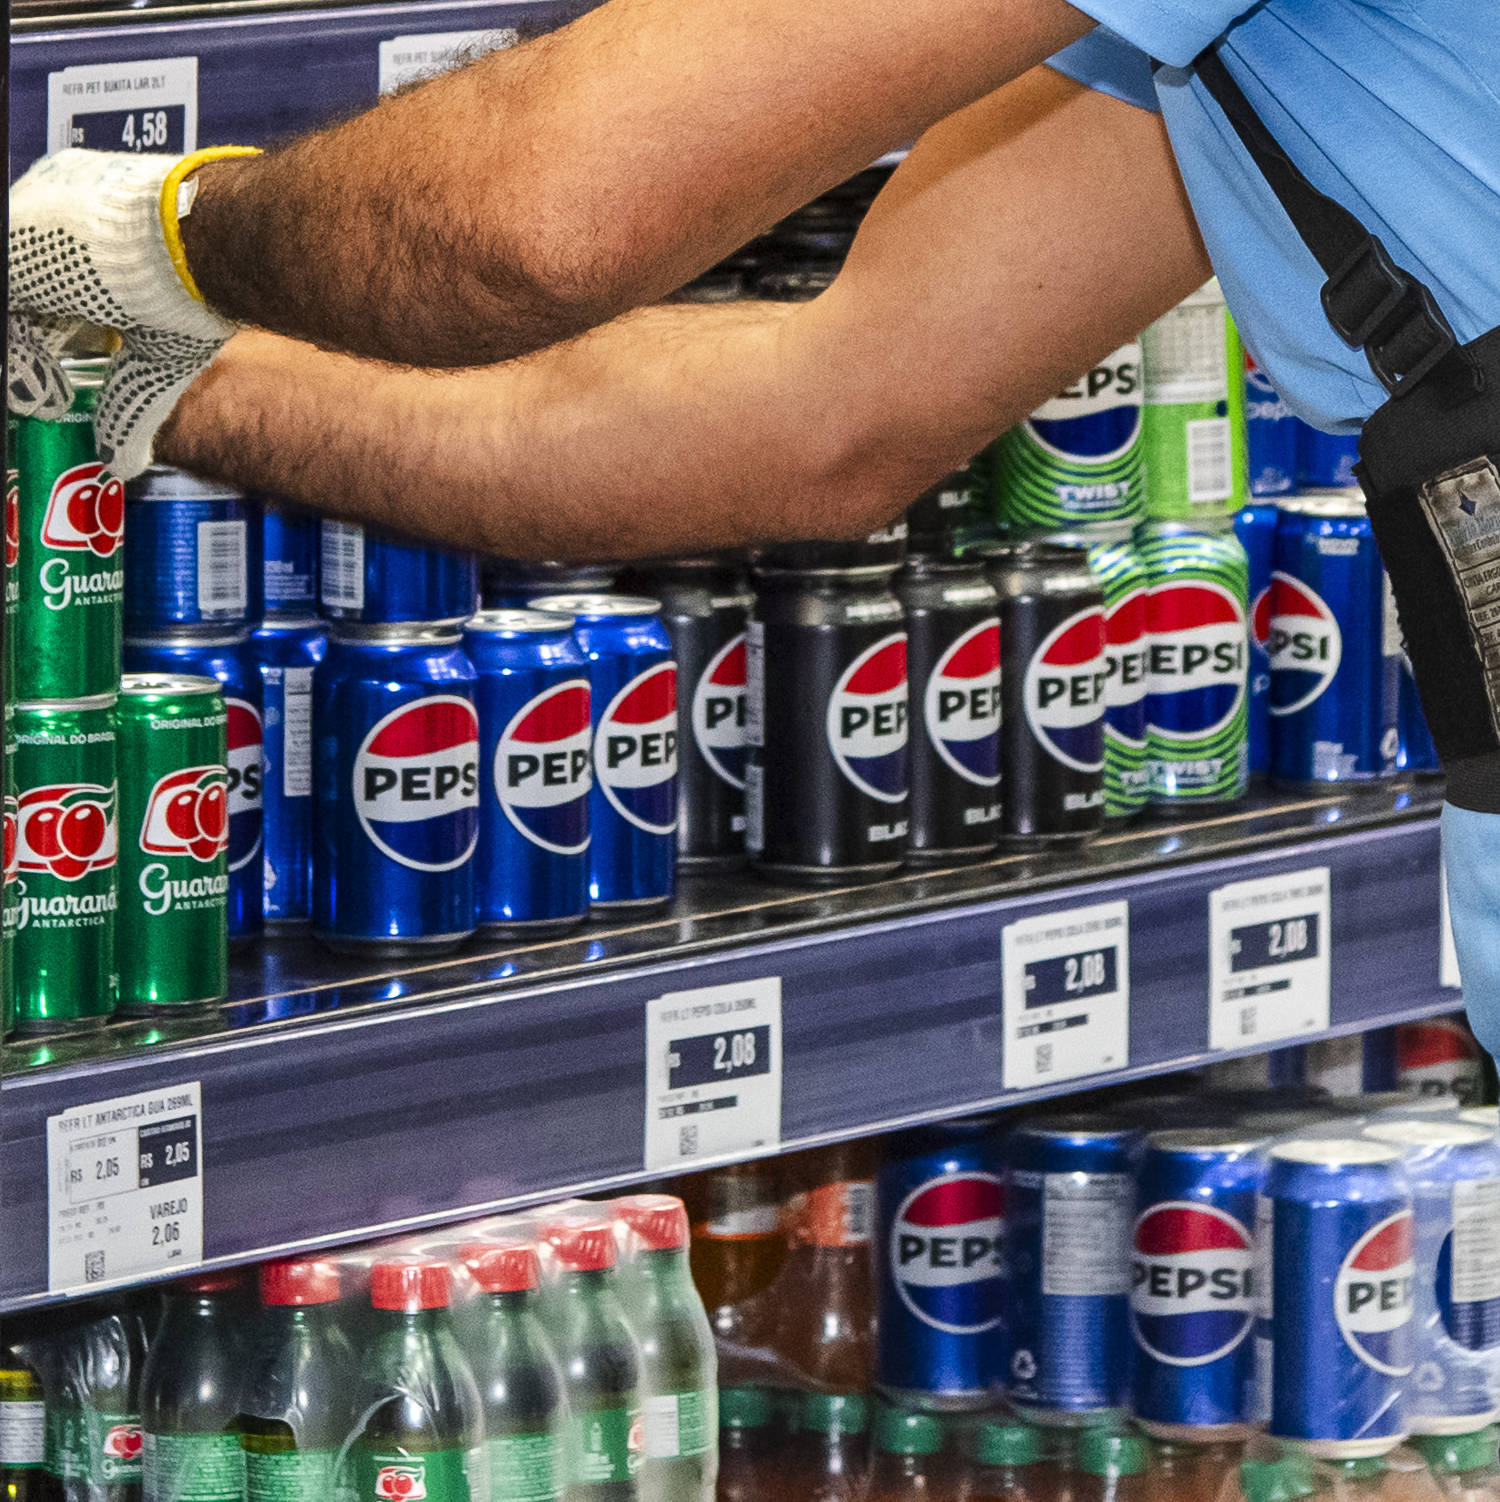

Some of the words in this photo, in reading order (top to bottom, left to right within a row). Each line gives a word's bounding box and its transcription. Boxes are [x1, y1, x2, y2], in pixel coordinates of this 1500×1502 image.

[86, 82, 100, 94] PET
[103, 79, 132, 93] SUKITA
[134, 77, 149, 89] LAR
[151, 75, 166, 88] 2LT
[121, 110, 168, 151] 4,58
[1056, 480, 1131, 502] TWIST
[151, 717, 203, 730] ORIGINAL
[31, 914, 105, 929] ANTARCTICA
[1064, 952, 1105, 995] 2,08
[713, 1031, 756, 1074] 2,08
[93, 1102, 147, 1128] ANTARCTICA
[140, 1152, 154, 1170] R$
[164, 1141, 190, 1168] 2,05
[70, 1168, 83, 1184] R$
[95, 1156, 120, 1182] 2,05
[149, 1197, 188, 1220] VAREJO
[151, 1221, 180, 1247] 2,06
